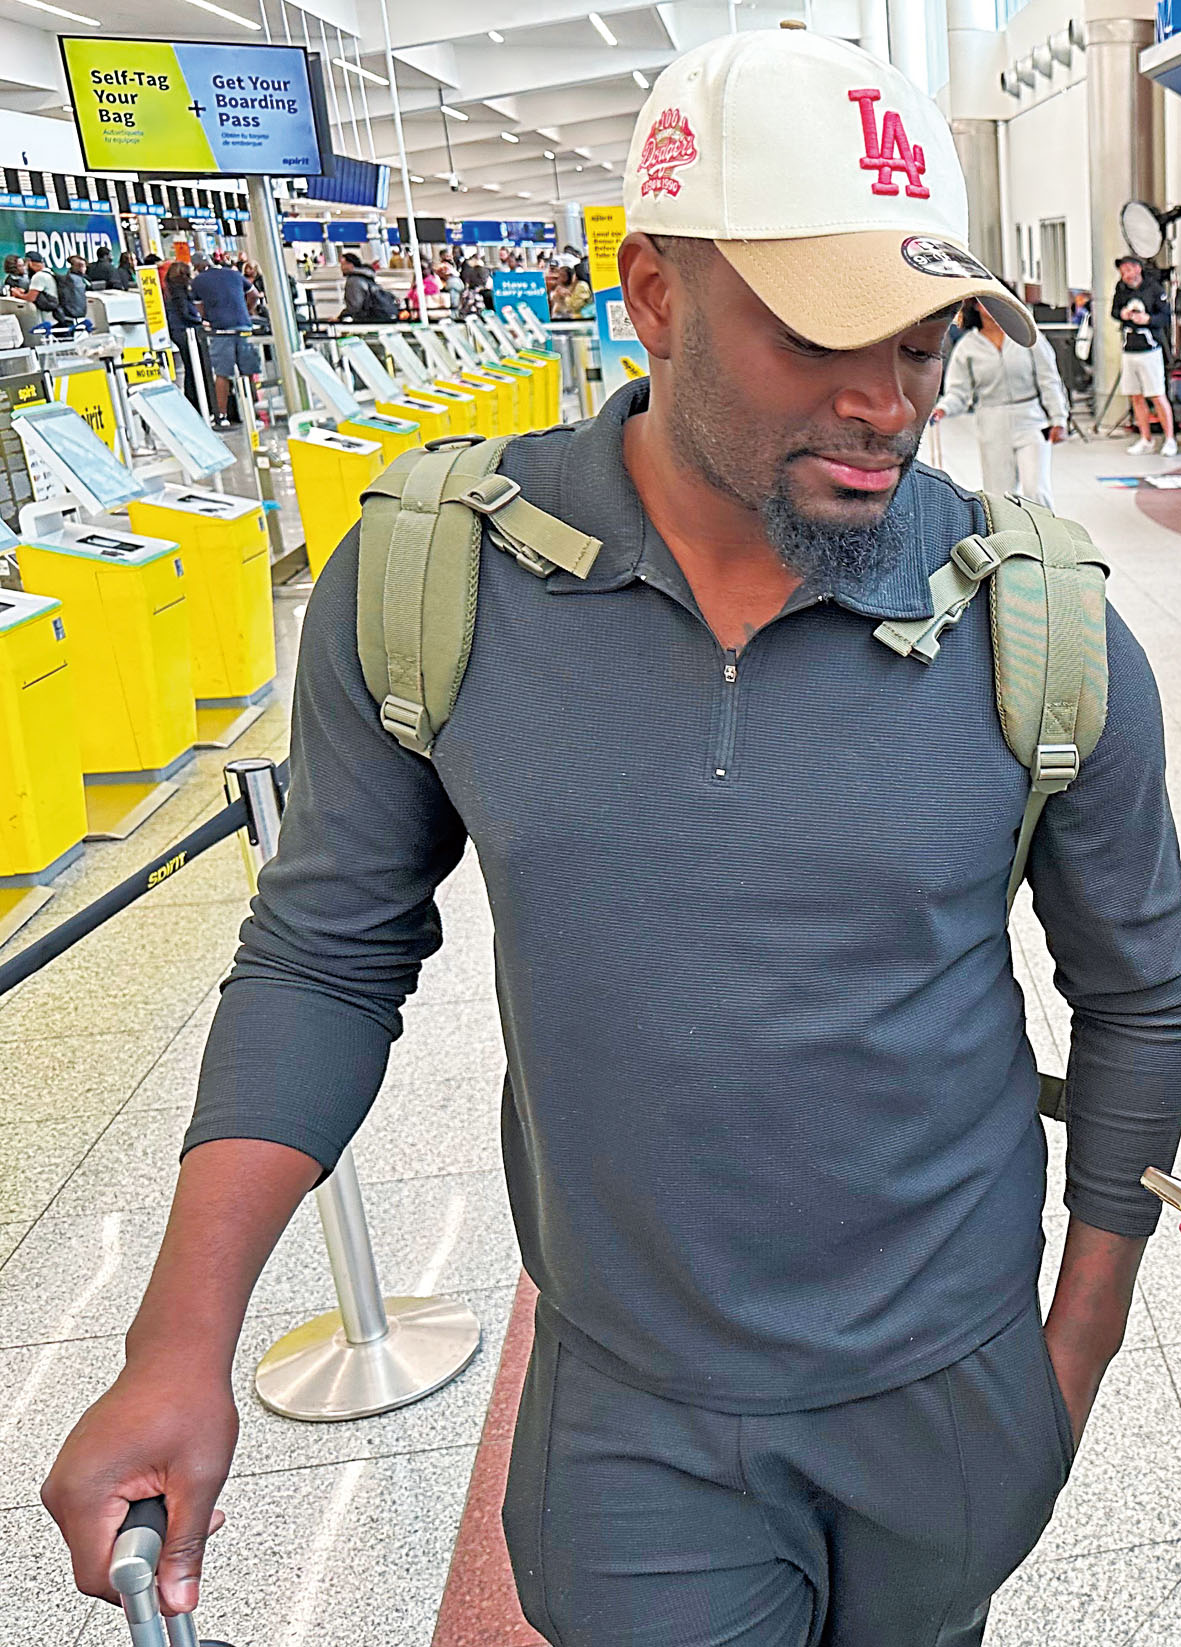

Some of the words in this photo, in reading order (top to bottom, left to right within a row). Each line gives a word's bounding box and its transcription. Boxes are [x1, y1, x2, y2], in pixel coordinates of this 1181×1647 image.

[91, 70, 170, 91] Self-Tag
[212, 74, 246, 90] Get
[247, 76, 291, 92] Your
[93, 89, 138, 105] Your
[215, 93, 298, 114] Boarding
[98, 108, 136, 128] Bag
[218, 112, 260, 128] Pass
[848, 88, 930, 200] LA
[81, 405, 105, 430] irit
